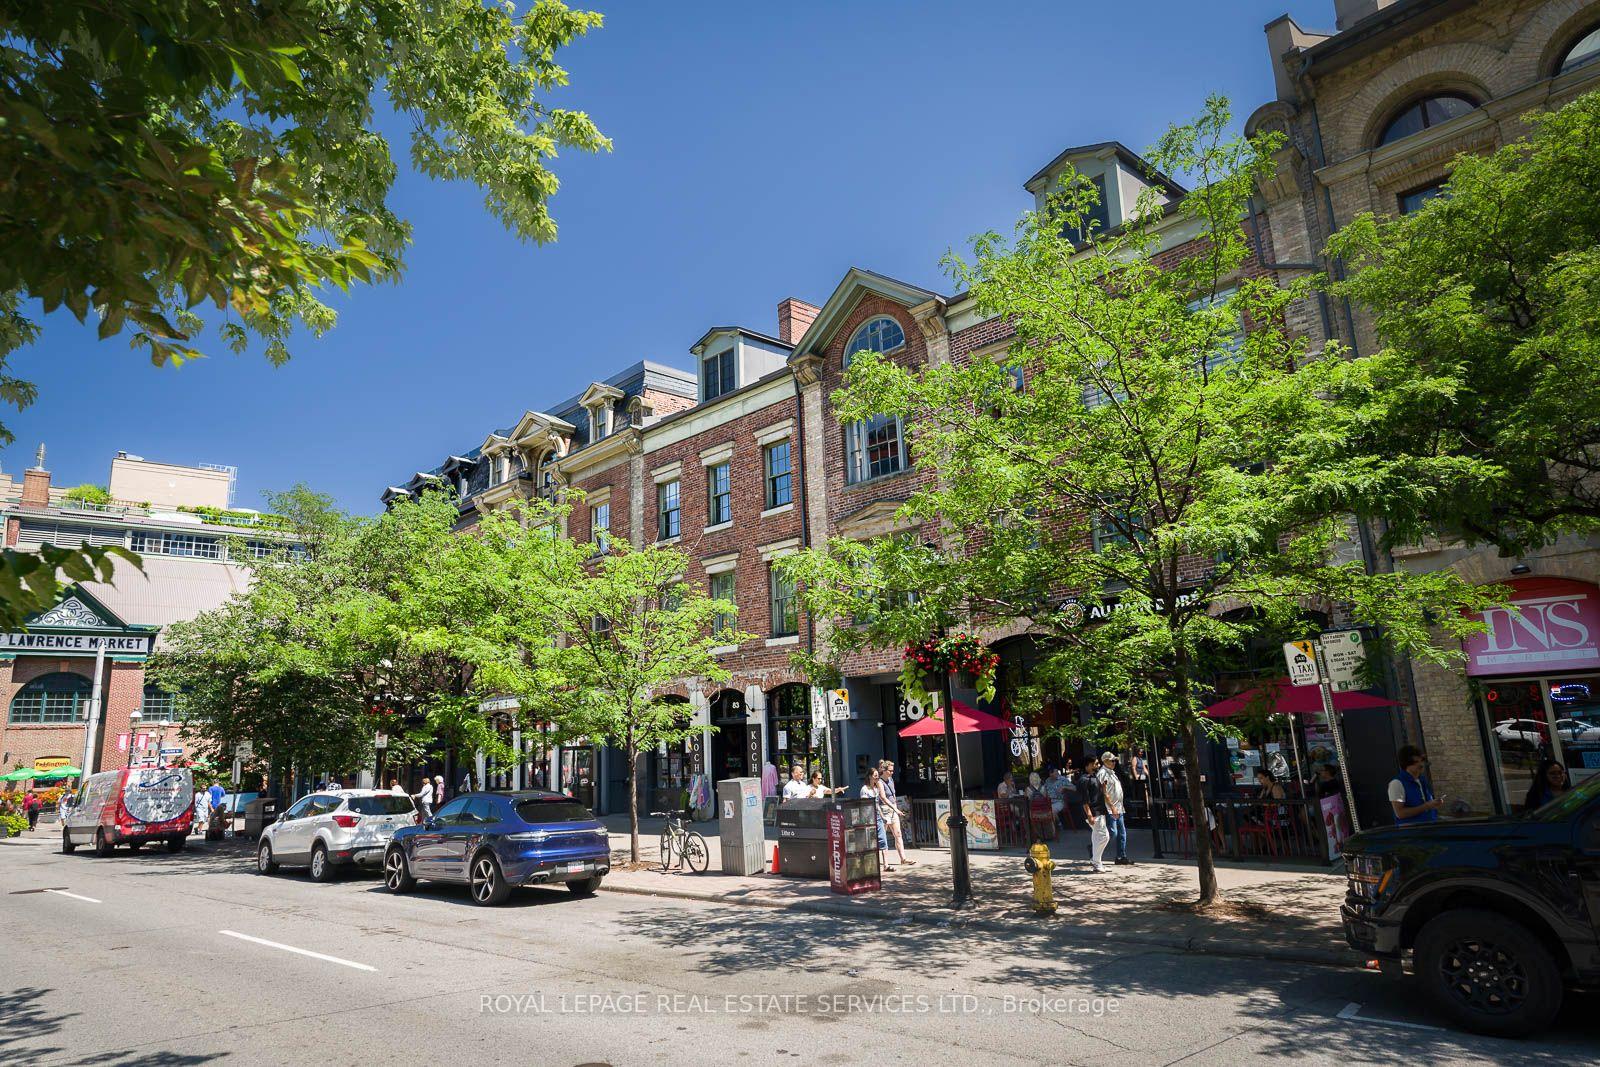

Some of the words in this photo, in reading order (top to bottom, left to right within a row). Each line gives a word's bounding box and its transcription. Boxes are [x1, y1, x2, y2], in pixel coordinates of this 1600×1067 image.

[1090, 605, 1111, 618] AU
[1481, 602, 1589, 652] INS
[9, 634, 82, 648] LAWRENCE
[1298, 663, 1314, 674] TAXI
[732, 701, 740, 709] 83
[832, 840, 841, 883] FREE
